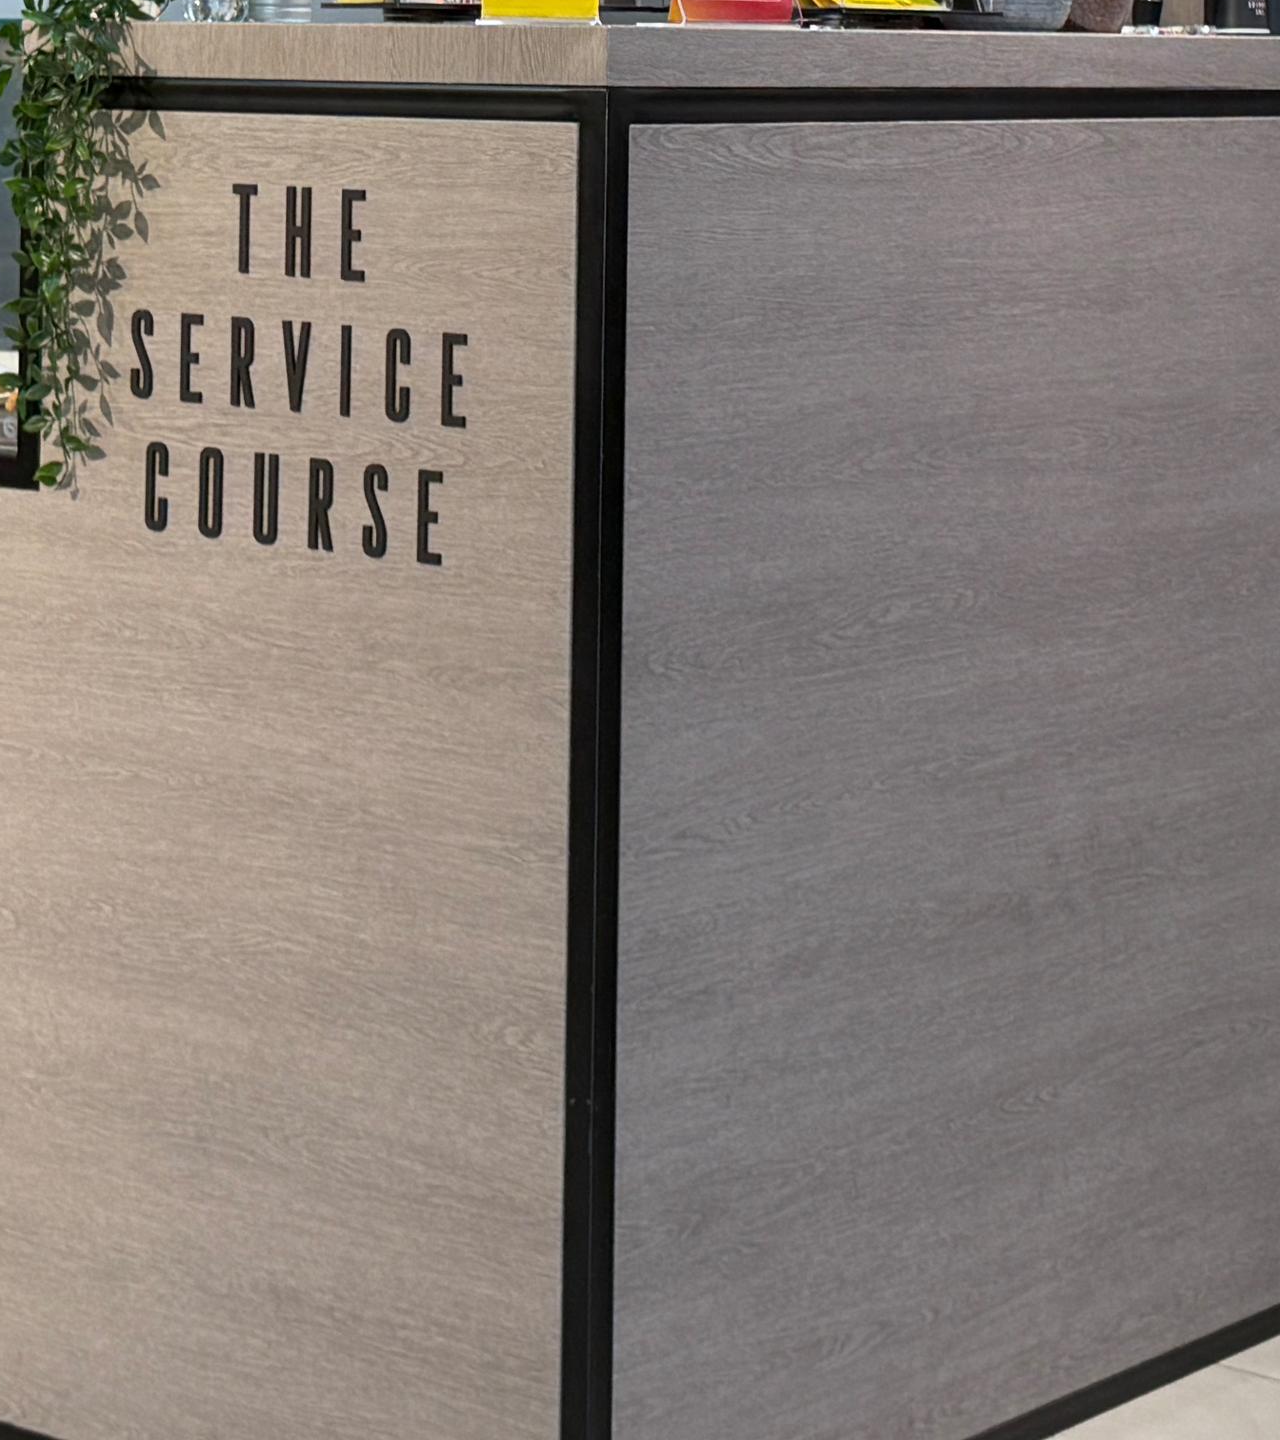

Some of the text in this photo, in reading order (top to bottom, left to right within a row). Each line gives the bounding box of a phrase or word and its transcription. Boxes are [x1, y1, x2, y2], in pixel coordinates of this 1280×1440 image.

[232, 183, 367, 282] THE
[130, 308, 468, 429] SERVICE
[144, 441, 444, 566] COURSE
